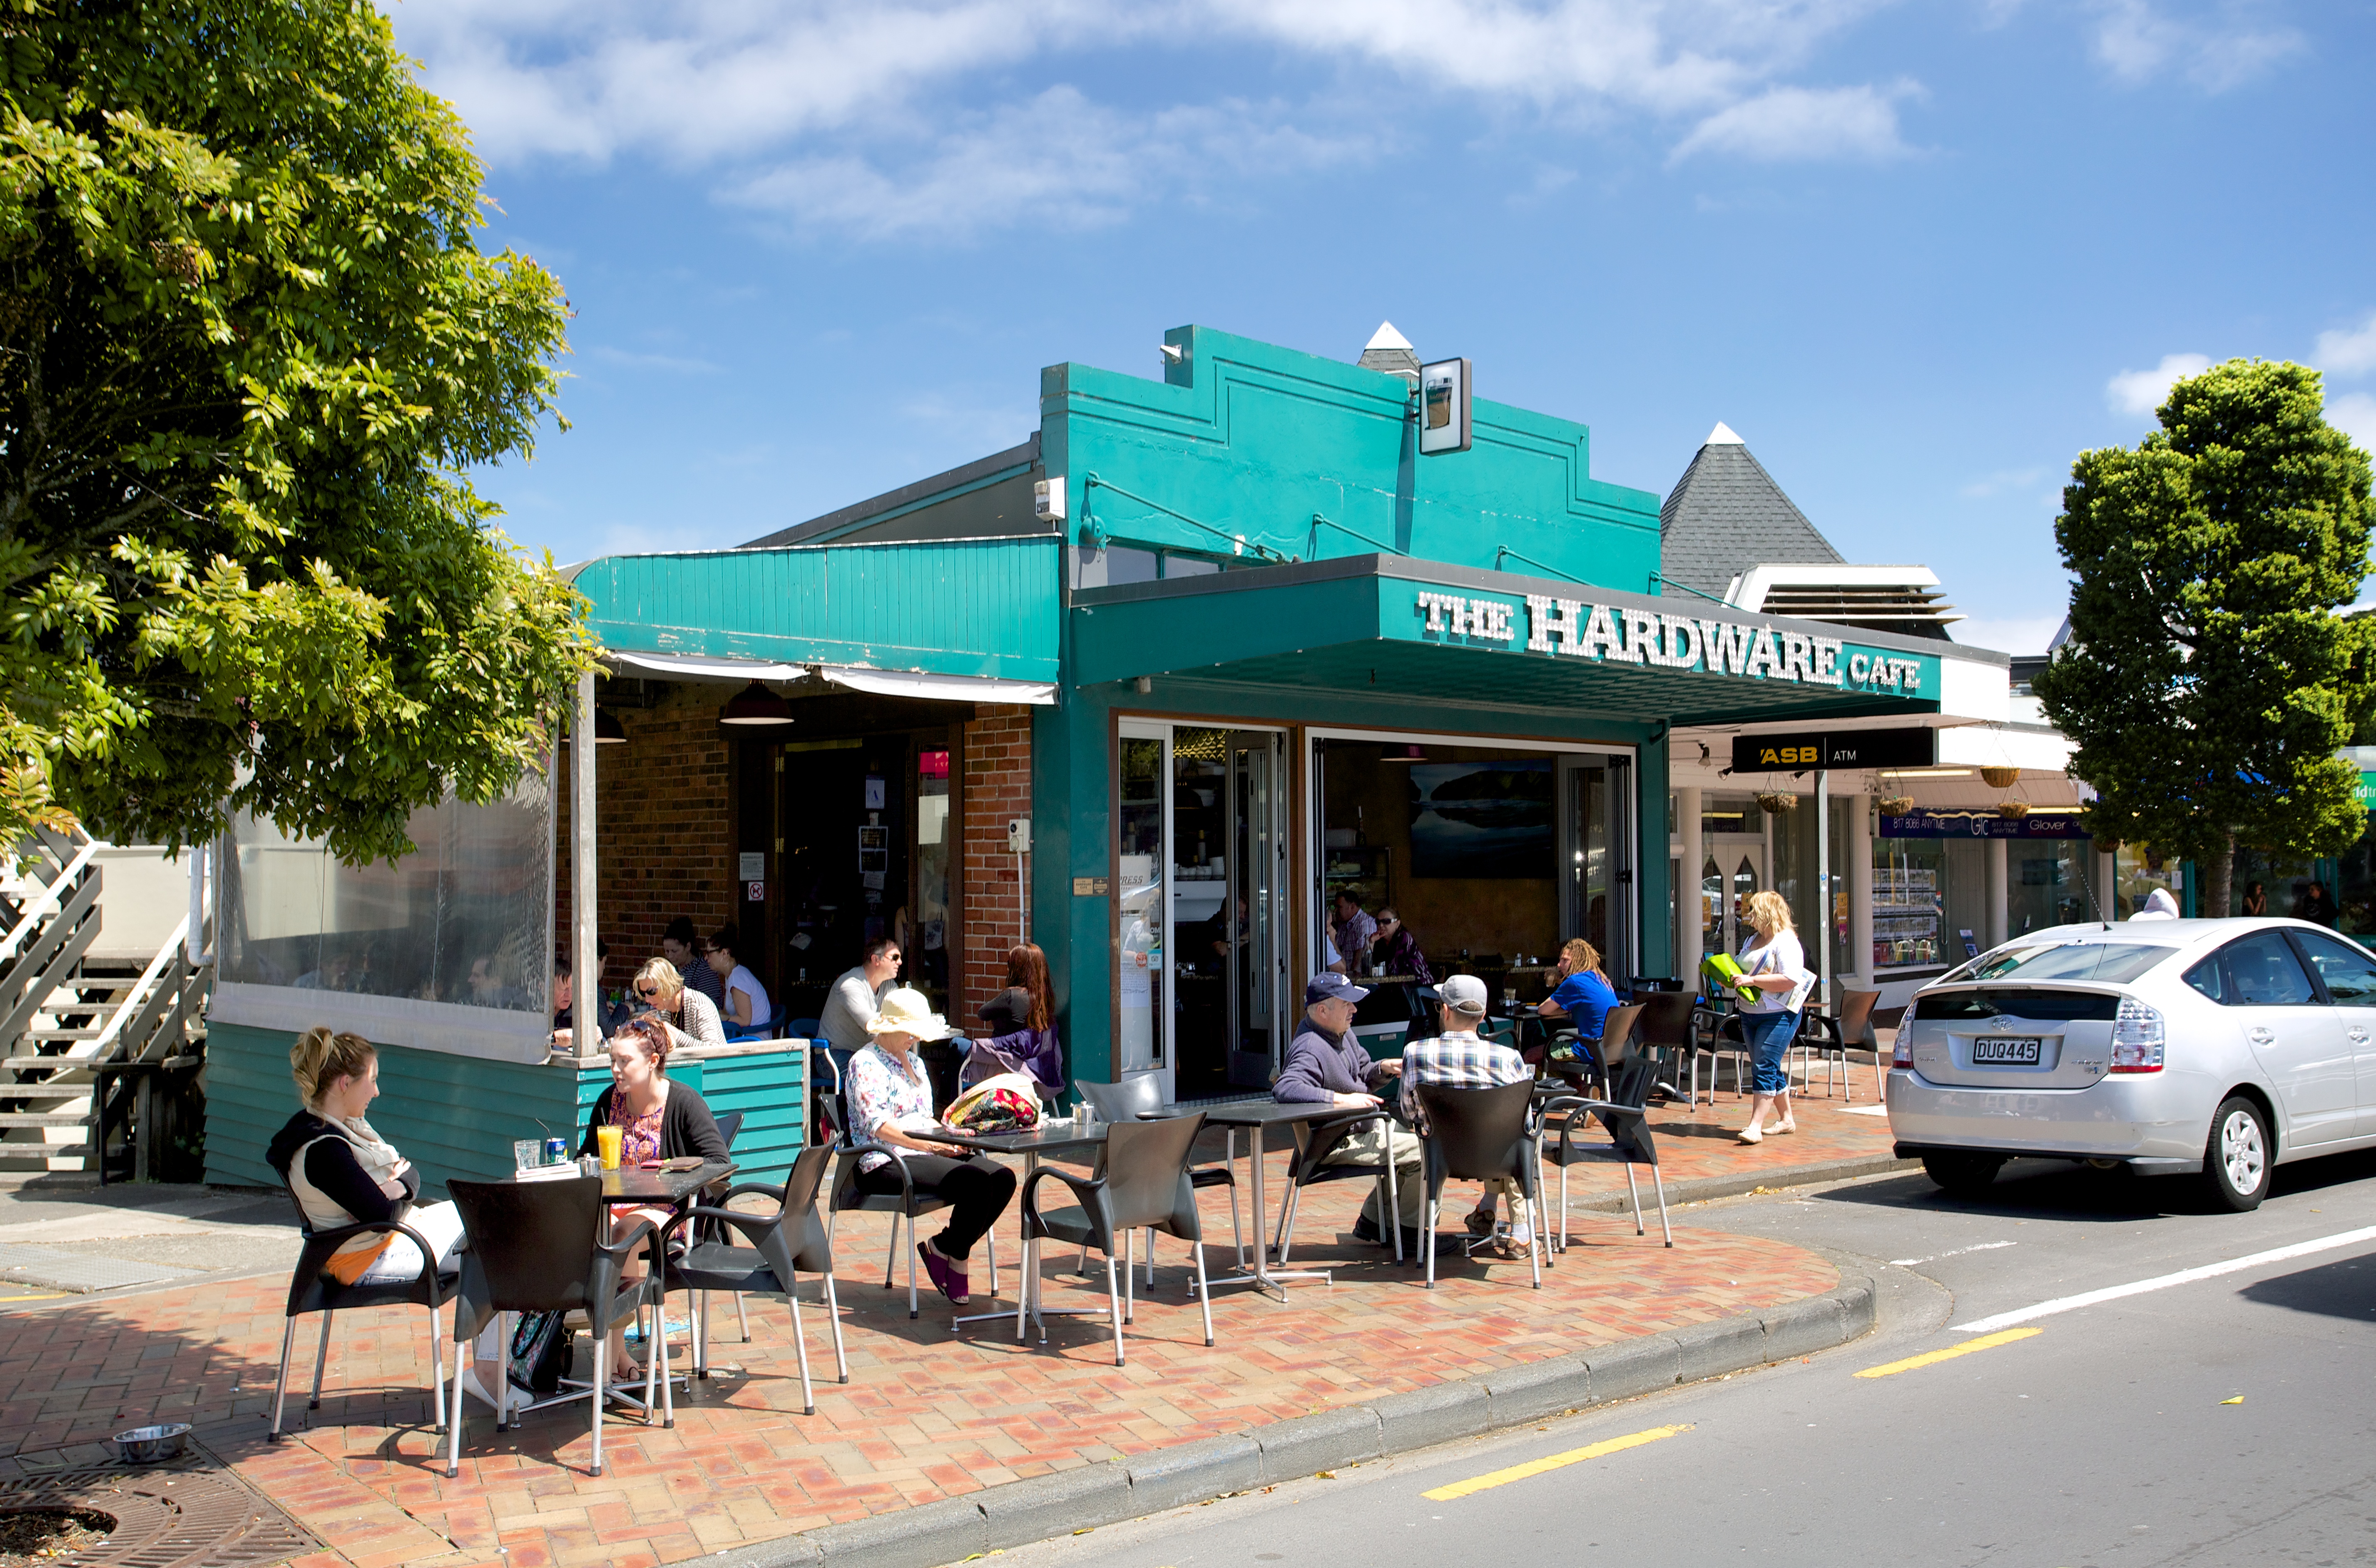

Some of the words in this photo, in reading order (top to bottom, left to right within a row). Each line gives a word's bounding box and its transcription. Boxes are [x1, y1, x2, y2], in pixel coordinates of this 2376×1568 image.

[1418, 591, 1514, 640] THE
[1527, 594, 1843, 685] HARDWARE
[1850, 653, 1921, 689] CAFE
[1760, 747, 1817, 764] ASB
[1834, 750, 1856, 762] ATM
[1893, 817, 1904, 829] 817
[1921, 818, 1945, 830] ANYTIME
[2029, 819, 2067, 830] Glover
[1977, 1042, 2036, 1059] DUQ445
